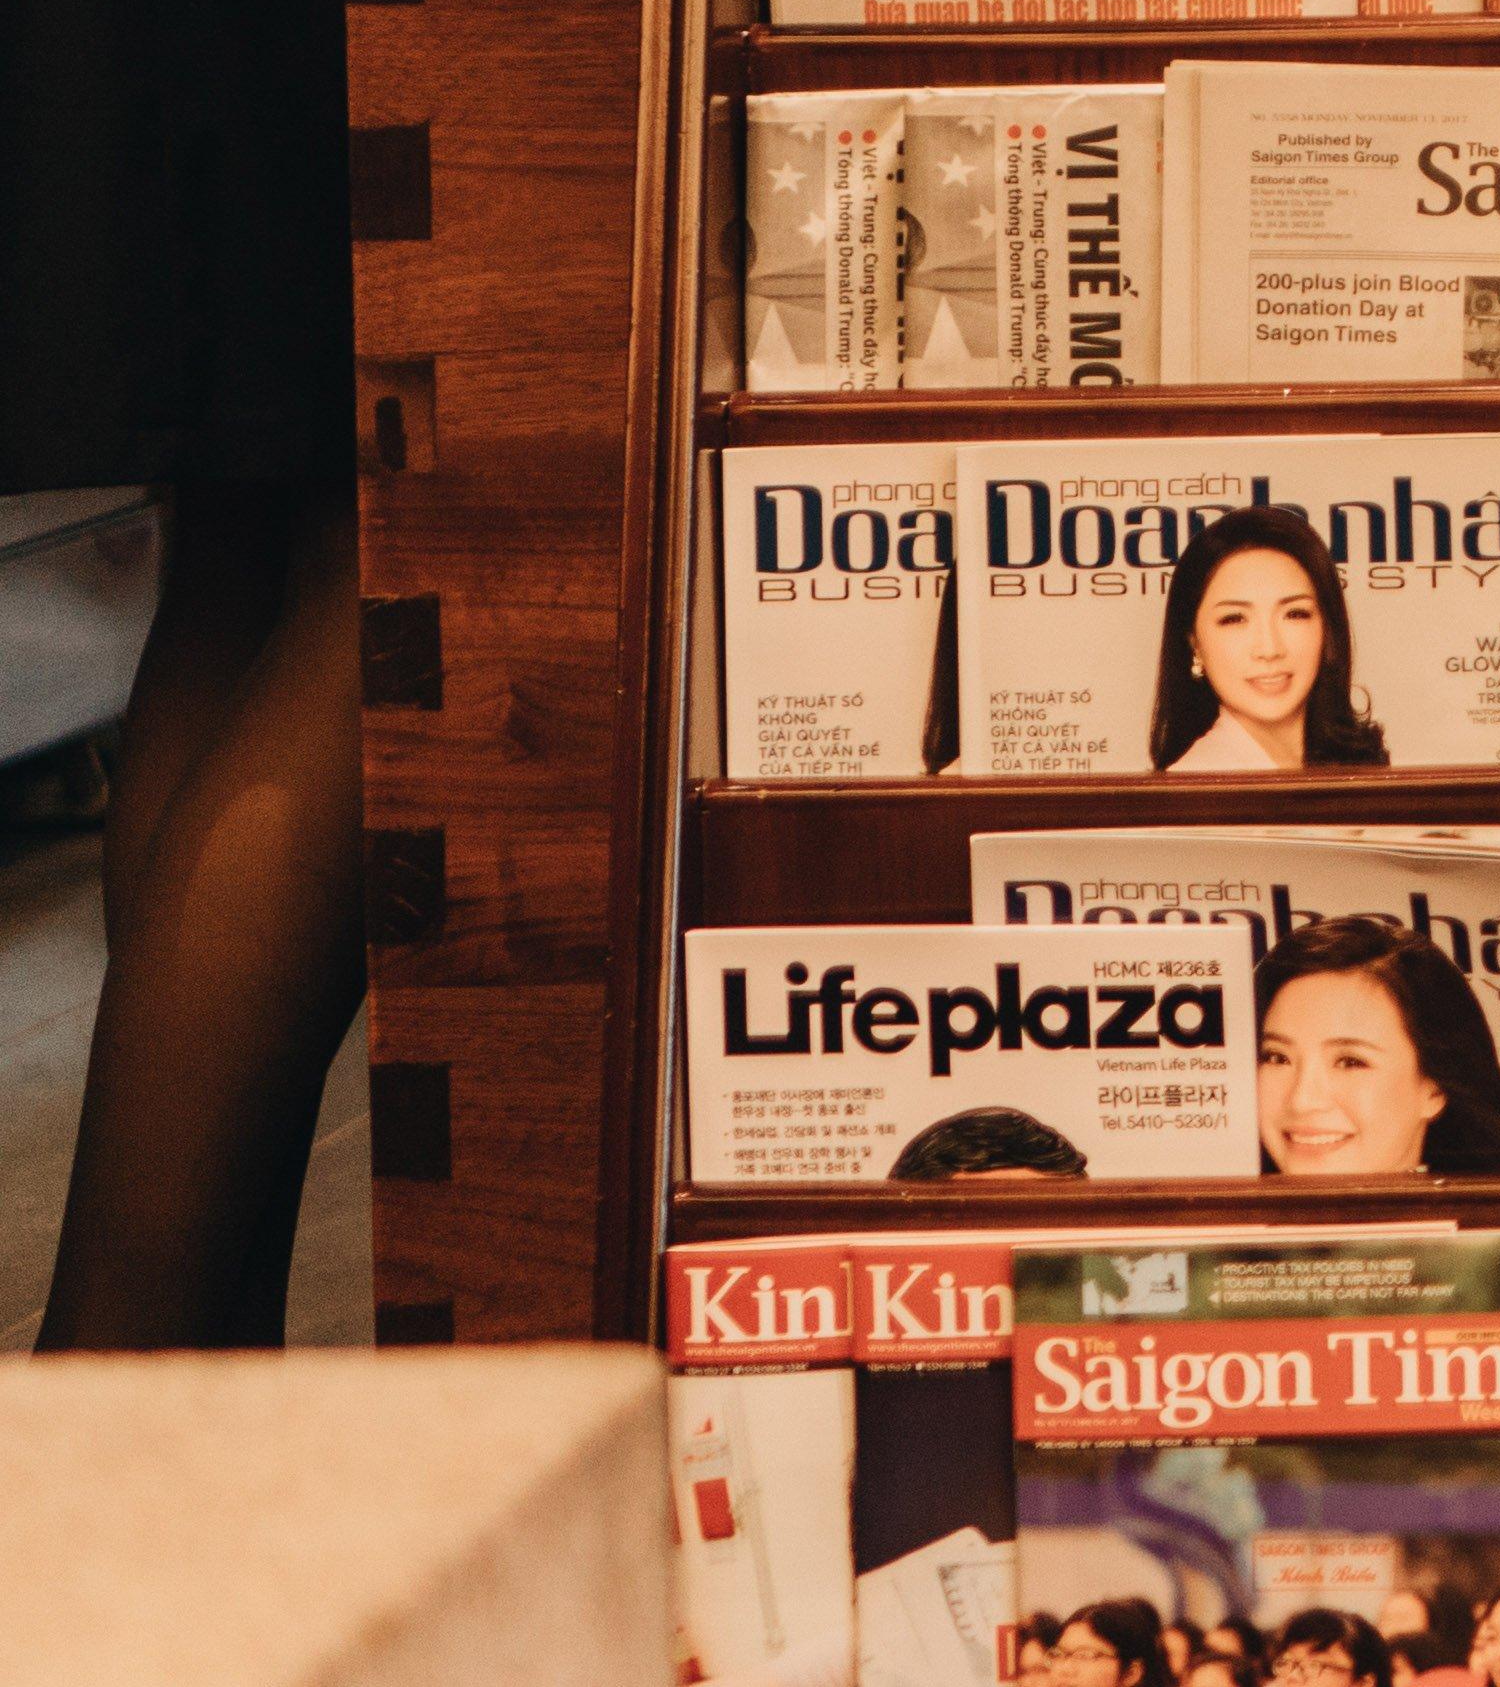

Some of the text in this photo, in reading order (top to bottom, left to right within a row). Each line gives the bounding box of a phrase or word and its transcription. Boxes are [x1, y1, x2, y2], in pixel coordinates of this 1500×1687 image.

[1278, 134, 1372, 149] Published by
[1466, 142, 1500, 157] The
[1252, 150, 1399, 165] Saigon Times Group
[1251, 176, 1329, 184] Editorial office
[1055, 124, 1139, 298] VỊ THẾ
[1256, 273, 1460, 295] 200-plus join Blood
[837, 247, 854, 369] Donald Trump:
[1008, 240, 1025, 365] Donald Trump:
[1256, 300, 1425, 322] Donation Day at
[1256, 324, 1397, 346] Saigon Times
[832, 480, 935, 508] phong
[1059, 472, 1242, 503] phong cách
[1080, 876, 1262, 907] phong cách
[1094, 962, 1152, 979] HCMC
[1098, 1057, 1227, 1072] Vietnam Life Plaza
[1098, 1084, 1228, 1108] 라이프플라자
[1290, 1262, 1309, 1274] TAX
[1275, 1276, 1294, 1287] TAX
[1298, 1276, 1322, 1287] MAY
[1325, 1275, 1341, 1286] BE
[1371, 1287, 1394, 1299] NOT
[1397, 1286, 1419, 1298] FAR
[1082, 1336, 1117, 1354] The
[1034, 1336, 1319, 1430] Saigon
